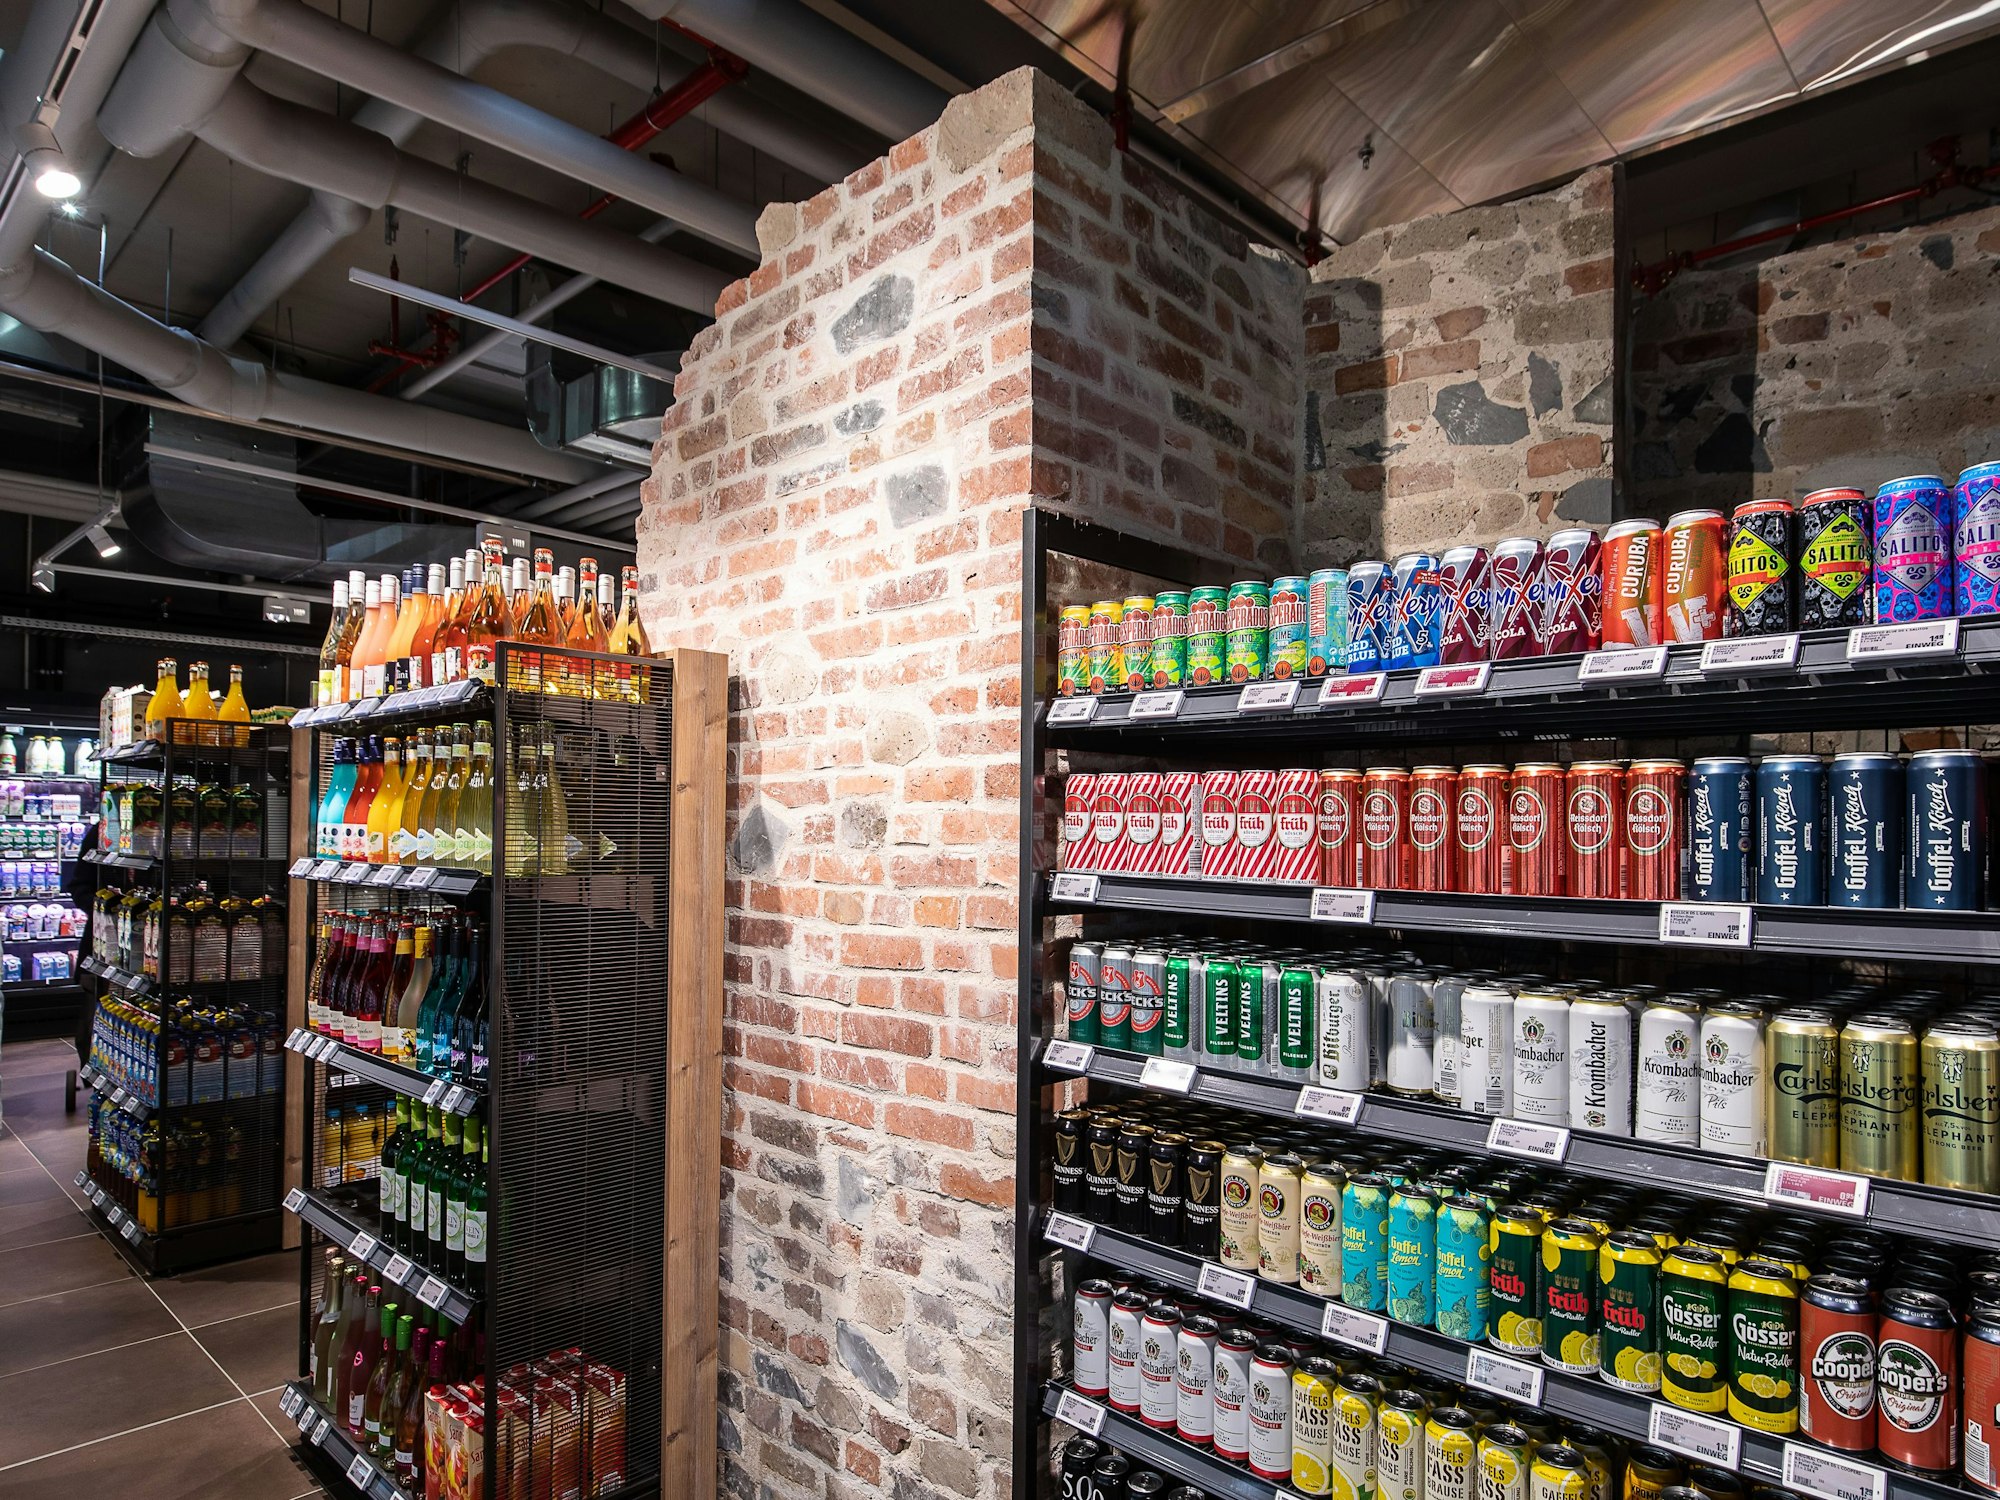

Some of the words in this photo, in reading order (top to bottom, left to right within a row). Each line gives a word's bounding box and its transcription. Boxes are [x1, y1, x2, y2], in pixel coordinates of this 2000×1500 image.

[1808, 542, 1873, 565] SALITOS
[1880, 533, 1949, 559] SALITOS
[1620, 535, 1650, 599] CURUBA
[1666, 529, 1692, 594] CURUBA
[1728, 553, 1779, 579] ALITOS
[1309, 581, 1327, 638] DESPERADOS
[1229, 634, 1253, 646] MOJITO
[1495, 627, 1526, 642] COLA
[1547, 622, 1577, 638] COLA
[1191, 637, 1215, 649] MOJITO
[1905, 641, 1944, 649] EINWEG
[1694, 783, 1715, 837] Kölsch
[1772, 782, 1799, 836] Kölsch
[1842, 781, 1869, 836] Kölsch
[1926, 779, 1955, 836] Kölsch
[1130, 815, 1155, 830] früh
[1204, 816, 1229, 831] früh
[1240, 816, 1265, 832] früh
[1280, 817, 1308, 833] früh
[1695, 836, 1714, 887] Gaffel
[1774, 836, 1799, 890] Gaffel
[1843, 837, 1869, 891] Gaffel
[1927, 837, 1955, 892] Gaffel
[1707, 932, 1740, 941] EINWEG
[1168, 973, 1179, 1029] VELTINS
[1215, 978, 1229, 1036] VELTINS
[1240, 981, 1252, 1040] VELTINS
[1287, 987, 1303, 1048] VELTINS
[1209, 1039, 1235, 1047] PILSENER
[1282, 1051, 1308, 1060] PILSENER
[1584, 1020, 1606, 1109] Krombacher
[1523, 1070, 1544, 1086] Pils
[1699, 1067, 1754, 1087] ombacher
[1662, 1088, 1690, 1105] Pils
[1705, 1094, 1728, 1111] Pils
[1840, 1075, 1918, 1112] rlsberg
[1527, 1145, 1555, 1156] EINWEG
[1928, 1138, 1958, 1151] STRONG
[1960, 1143, 1984, 1152] BEER
[1089, 1185, 1116, 1194] DRAUGHT
[1149, 1203, 1175, 1214] DRAUGHT
[1184, 1197, 1220, 1215] GUINNESS
[1305, 1195, 1334, 1212] PAULANER
[1186, 1212, 1214, 1224] DRAUGHT
[1391, 1235, 1422, 1259] Gaffel
[1437, 1246, 1466, 1268] Gaffel
[1391, 1251, 1422, 1267] Lemon
[1437, 1262, 1466, 1280] Lemon
[1489, 1266, 1525, 1298] früh
[1547, 1285, 1589, 1315] früh
[1602, 1298, 1646, 1332] früh
[1663, 1294, 1722, 1329] Gösser
[1666, 1325, 1720, 1351] NaturRadler
[1732, 1312, 1796, 1347] Gösser
[1354, 1335, 1377, 1349] EINWEG
[1737, 1344, 1795, 1370] NaturRadler
[1504, 1384, 1532, 1400] EINWEG
[1843, 1381, 1865, 1389] CIDER
[1294, 1389, 1328, 1408] GAFFELS
[1834, 1388, 1872, 1404] Original
[1886, 1395, 1927, 1414] Original
[1893, 1390, 1917, 1402] CIDER
[1294, 1401, 1329, 1427] FASS
[1334, 1406, 1361, 1426] AFFELS
[1294, 1420, 1328, 1441] BRAUSE
[1334, 1420, 1361, 1446] ASS
[1426, 1440, 1465, 1464] GAFFELS
[1696, 1444, 1729, 1462] EINWEG
[1378, 1455, 1399, 1475] AUSE
[1426, 1454, 1465, 1486] FASS
[1426, 1475, 1465, 1500] BRAUSE
